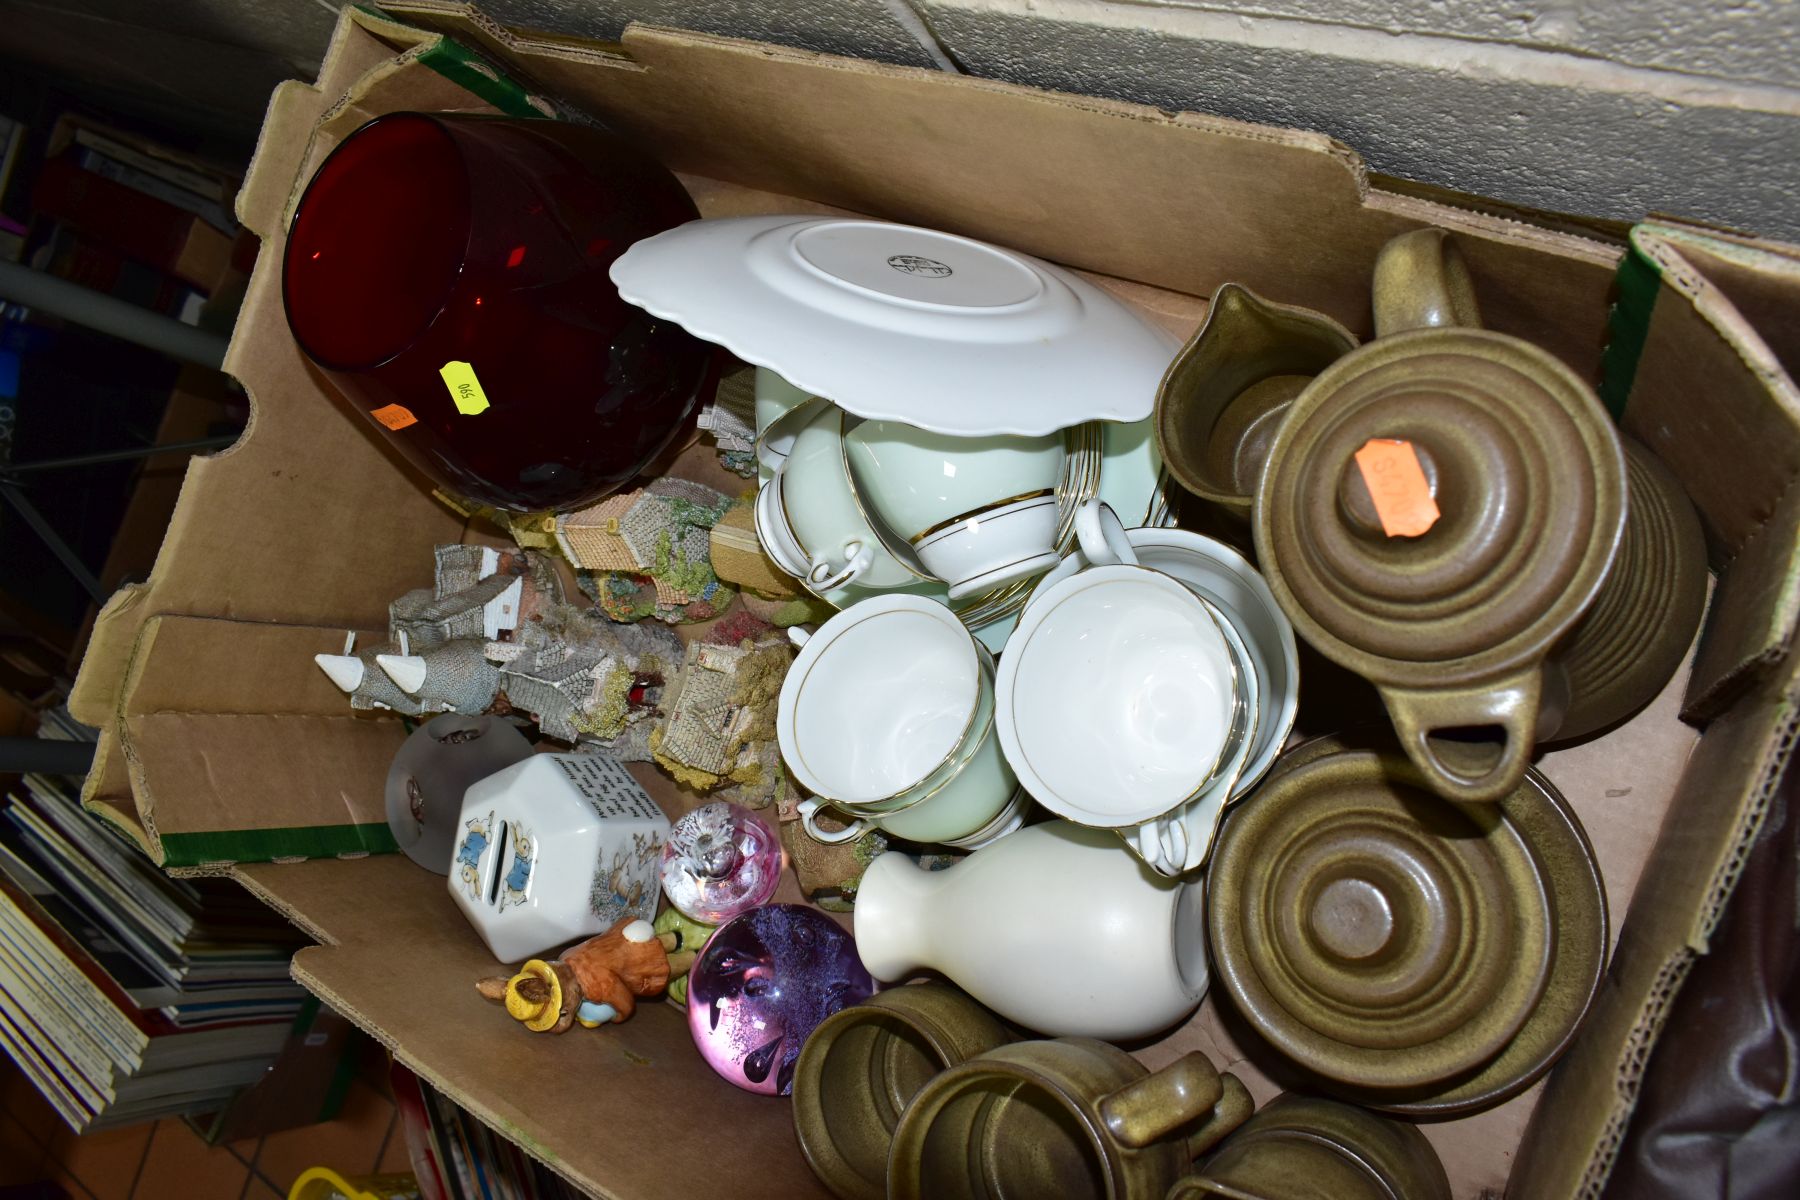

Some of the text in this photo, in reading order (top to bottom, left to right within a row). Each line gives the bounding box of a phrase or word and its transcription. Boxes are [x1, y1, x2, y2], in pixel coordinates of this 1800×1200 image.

[458, 383, 476, 400] 590
[567, 761, 582, 772] and
[551, 756, 607, 818] Peter gave himself
[600, 784, 609, 793] big
[596, 793, 606, 801] for
[617, 792, 626, 801] his
[639, 791, 660, 815] friendly
[607, 806, 616, 815] up
